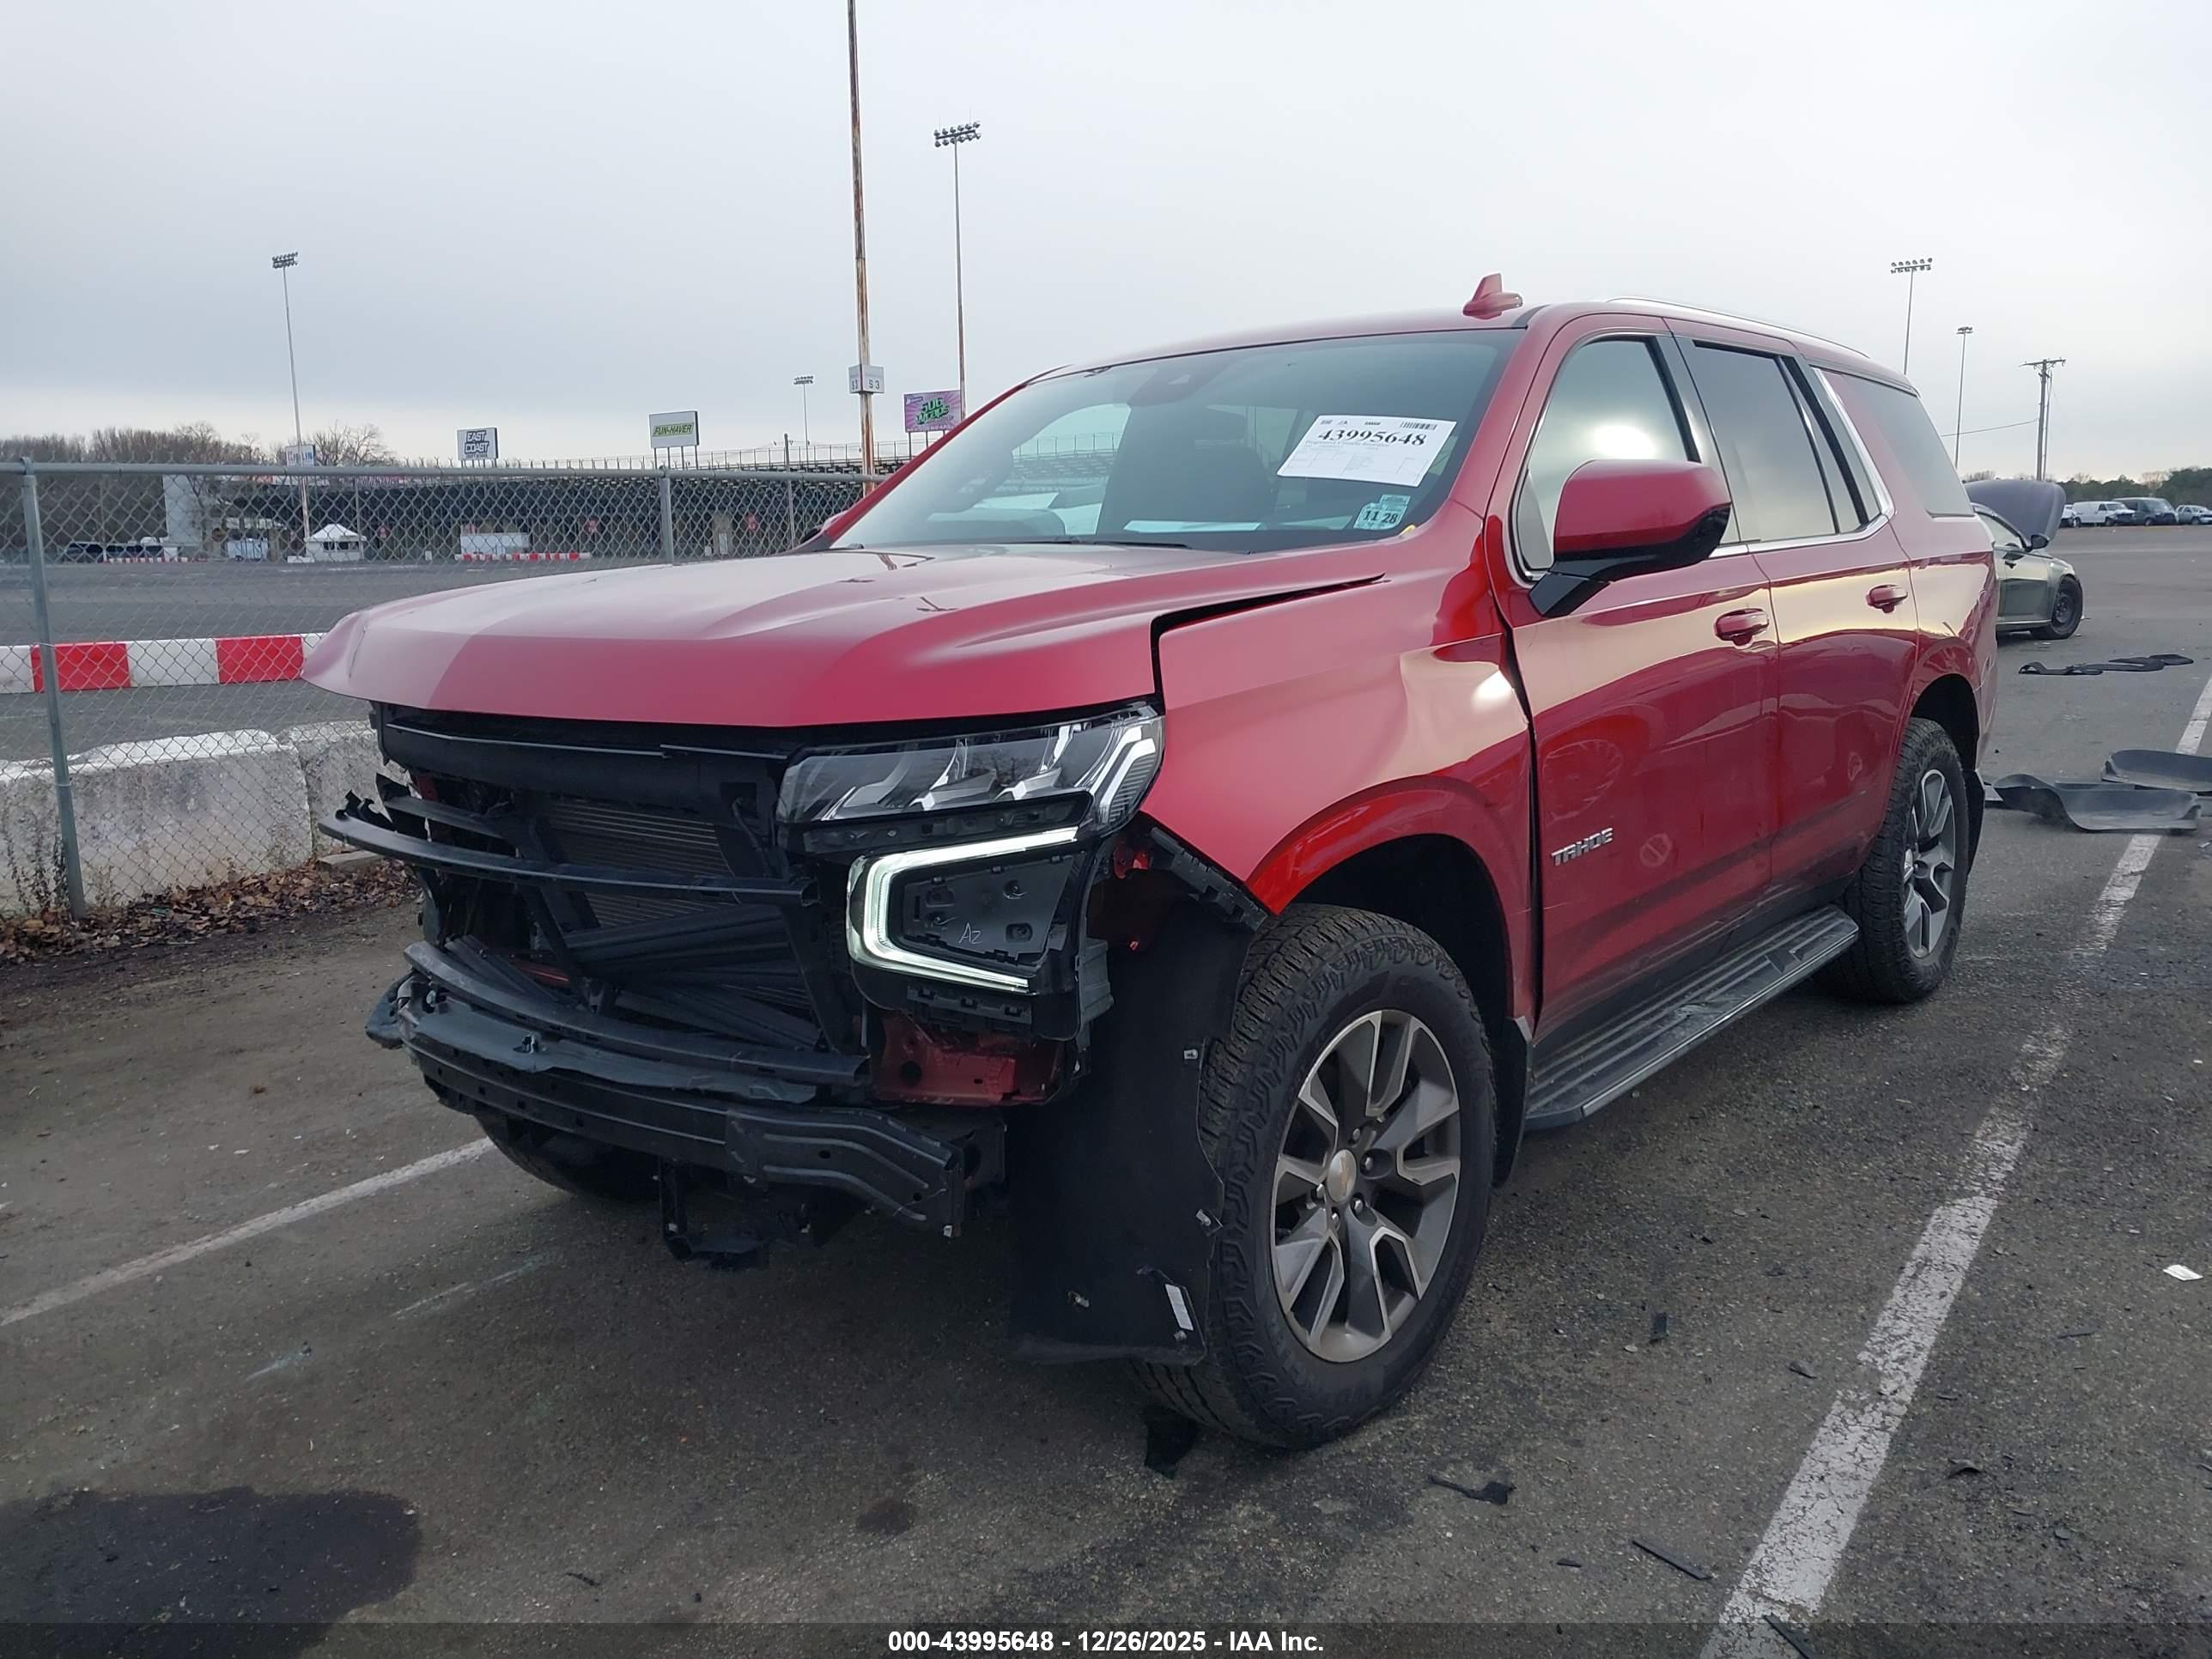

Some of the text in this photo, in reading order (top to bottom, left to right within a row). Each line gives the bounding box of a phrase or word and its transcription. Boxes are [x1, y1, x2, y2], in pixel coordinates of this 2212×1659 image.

[466, 430, 486, 442] EAST
[1317, 428, 1427, 446] 43995648
[465, 441, 489, 453] COAST
[1363, 510, 1399, 523] 11 28
[1551, 827, 1613, 866] TAHOE
